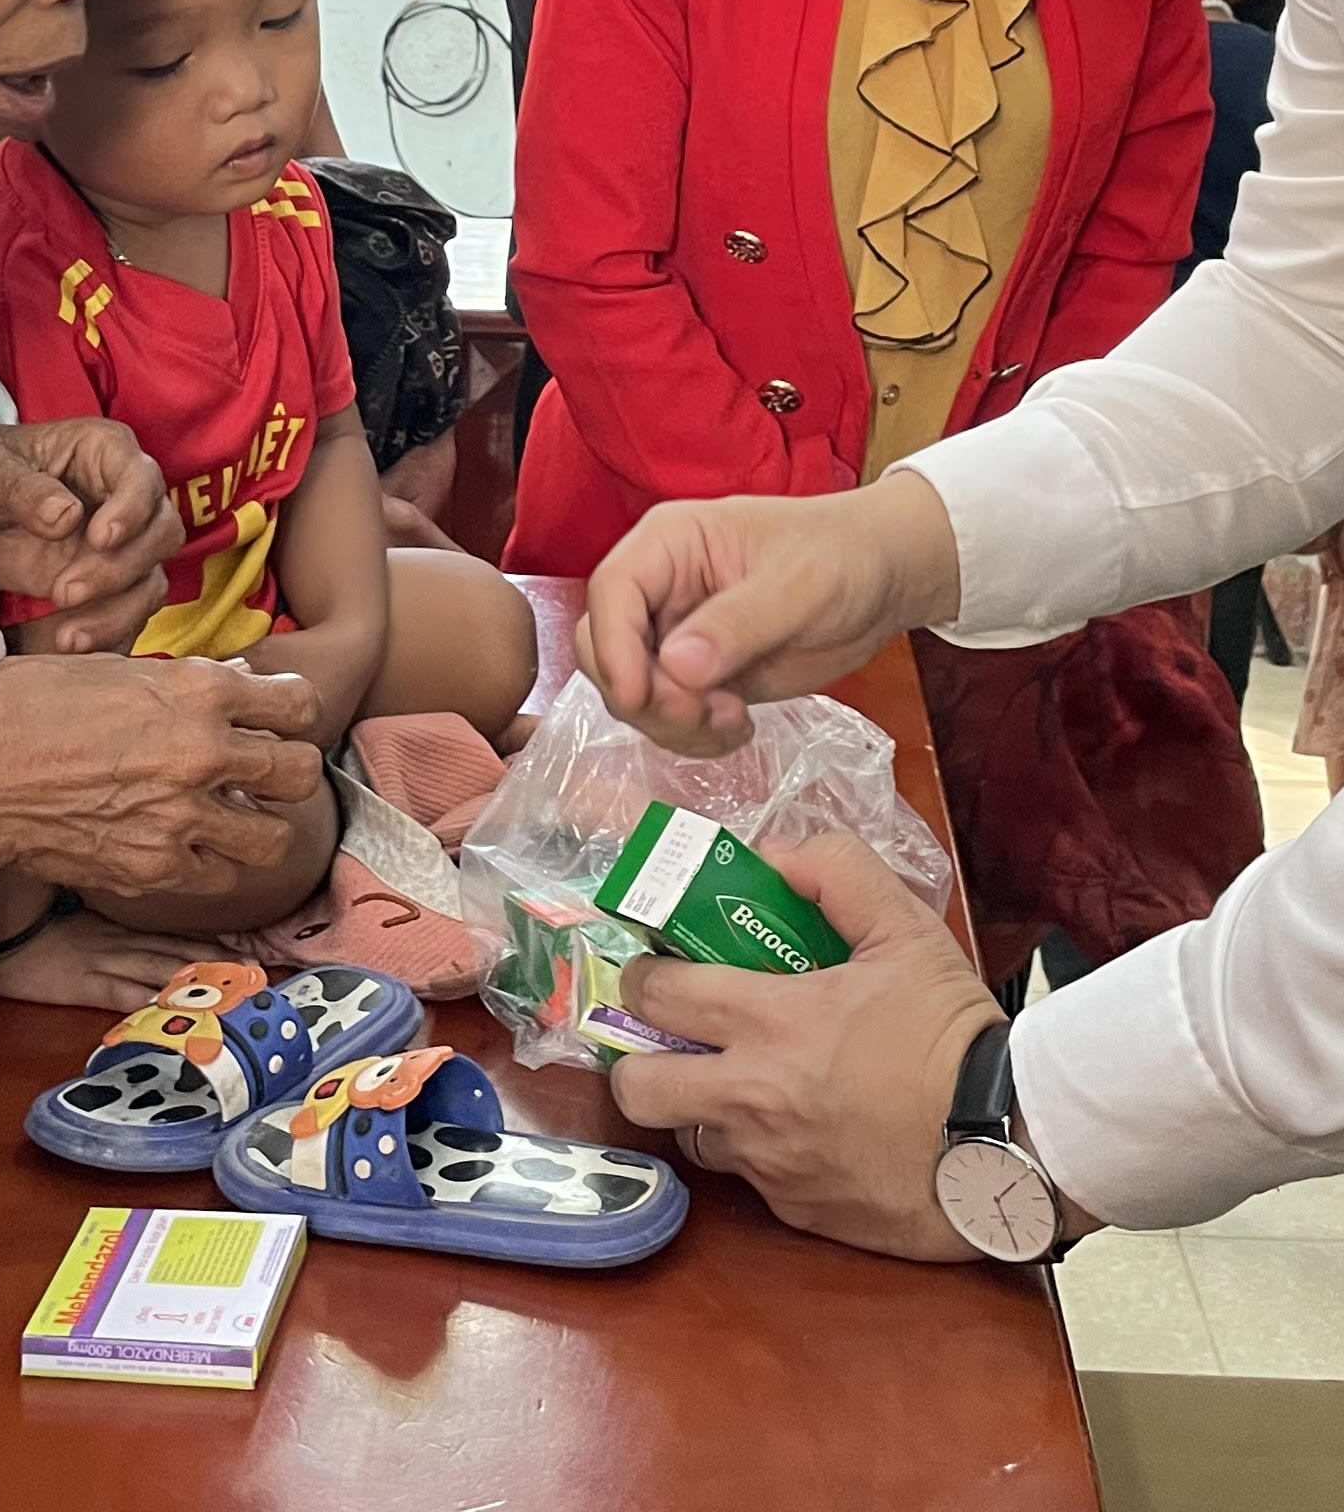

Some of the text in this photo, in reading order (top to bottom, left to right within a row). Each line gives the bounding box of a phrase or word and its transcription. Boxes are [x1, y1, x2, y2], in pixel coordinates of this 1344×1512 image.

[730, 903, 811, 974] Berocca
[52, 1228, 125, 1327] Mebendazol
[67, 1339, 212, 1365] MEBENDAZOL 500mg
